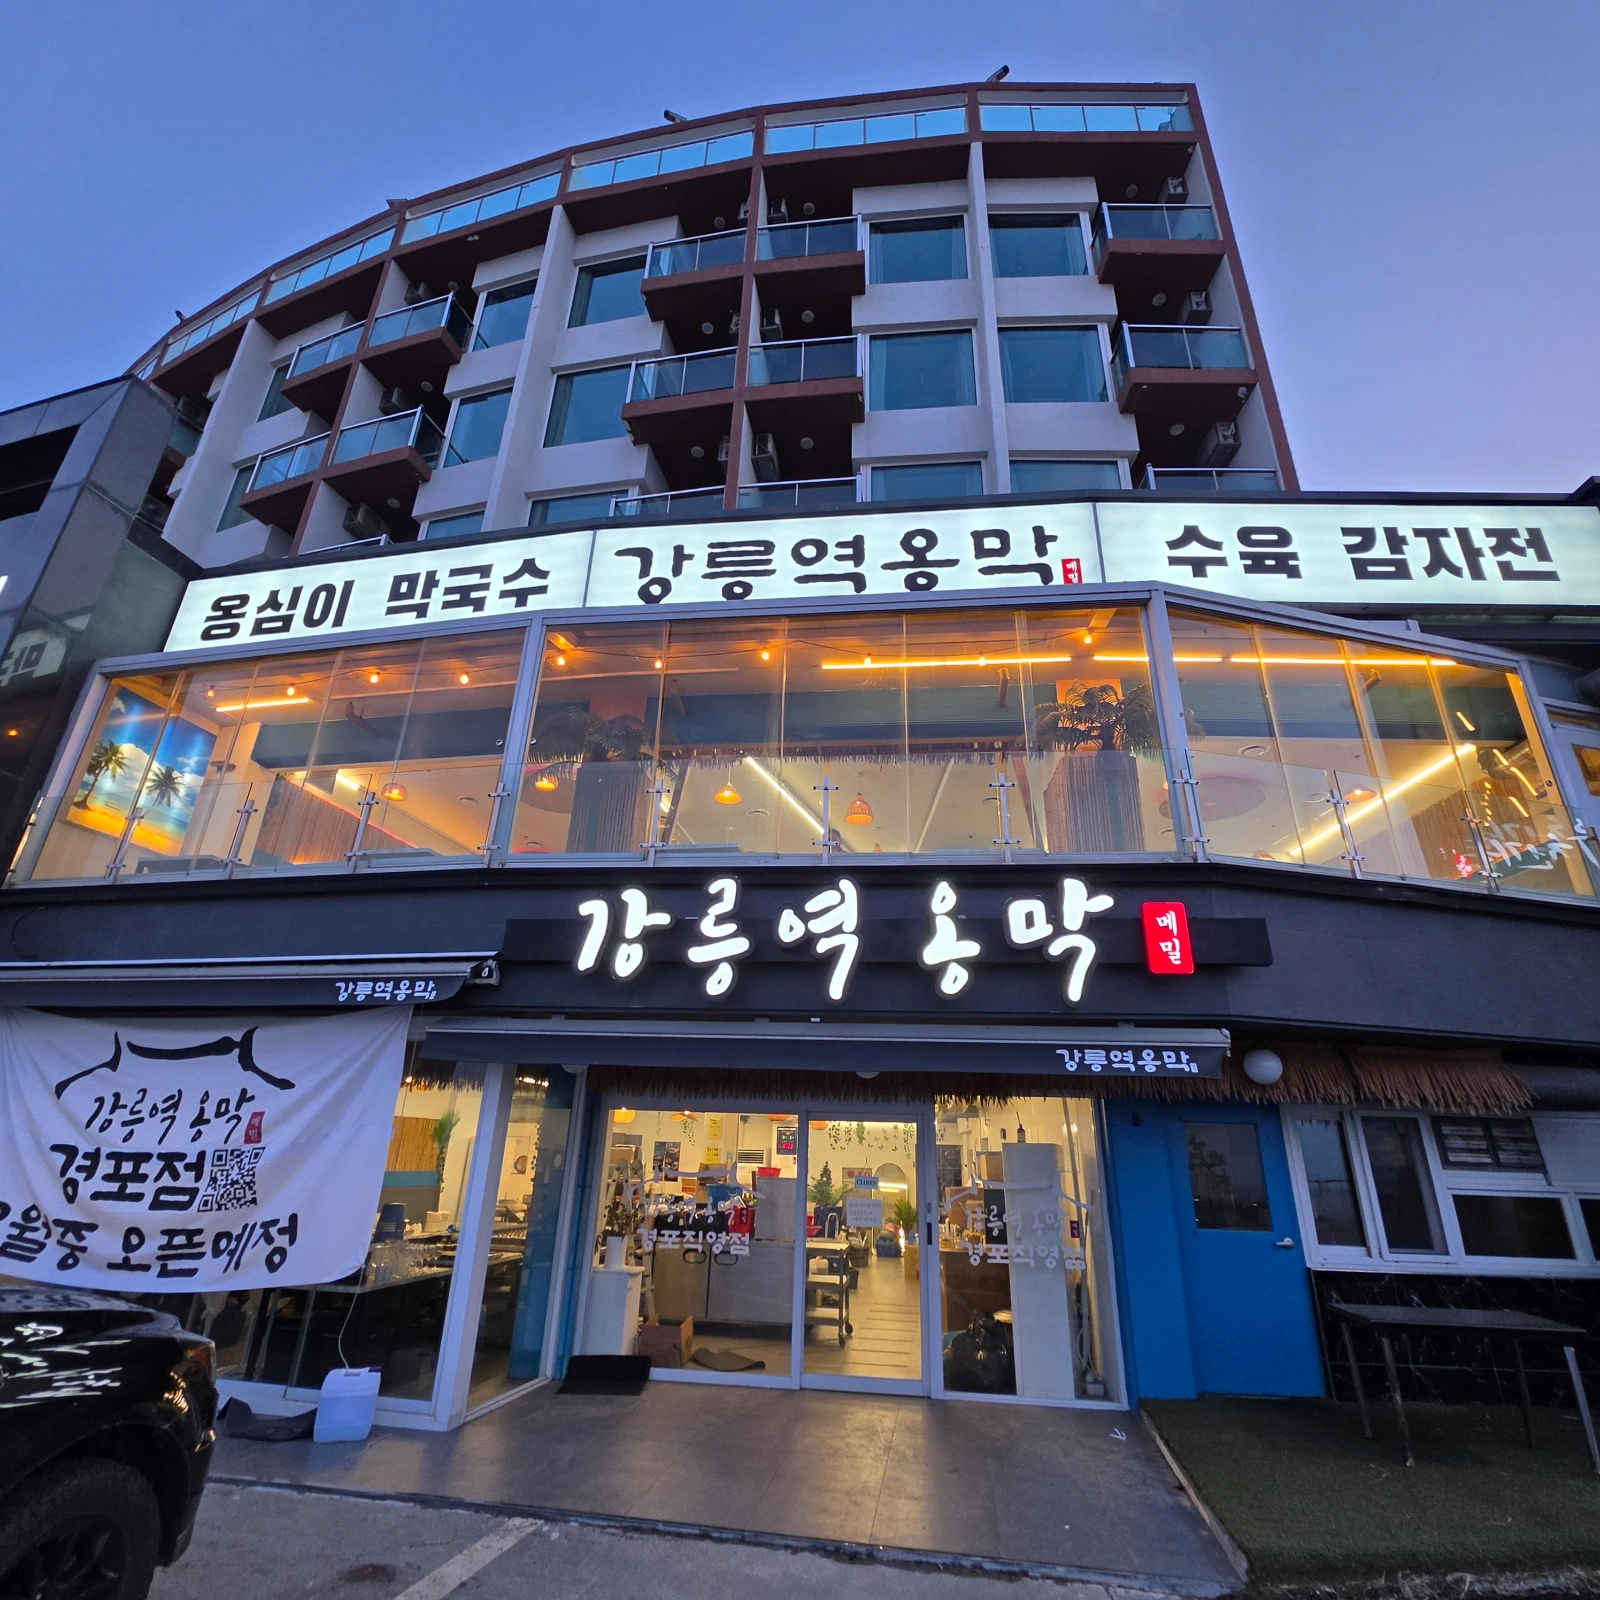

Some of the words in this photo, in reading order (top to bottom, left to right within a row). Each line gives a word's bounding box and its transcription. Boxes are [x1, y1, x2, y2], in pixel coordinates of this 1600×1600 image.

[615, 525, 1058, 604] 강릉역옹막
[1165, 525, 1303, 579] 수육
[1340, 526, 1561, 582] 감자전
[200, 580, 355, 641] 옹심이
[385, 558, 551, 618] 막국수
[1155, 910, 1182, 965] 메밀
[335, 980, 436, 1001] 강릉역옹막
[1056, 1049, 1190, 1073] 강릉역옹막
[248, 1115, 262, 1141] 메밀
[50, 1144, 206, 1211] 경포점
[637, 1228, 750, 1256] 경포직영점
[960, 1241, 1086, 1271] 경포직영점
